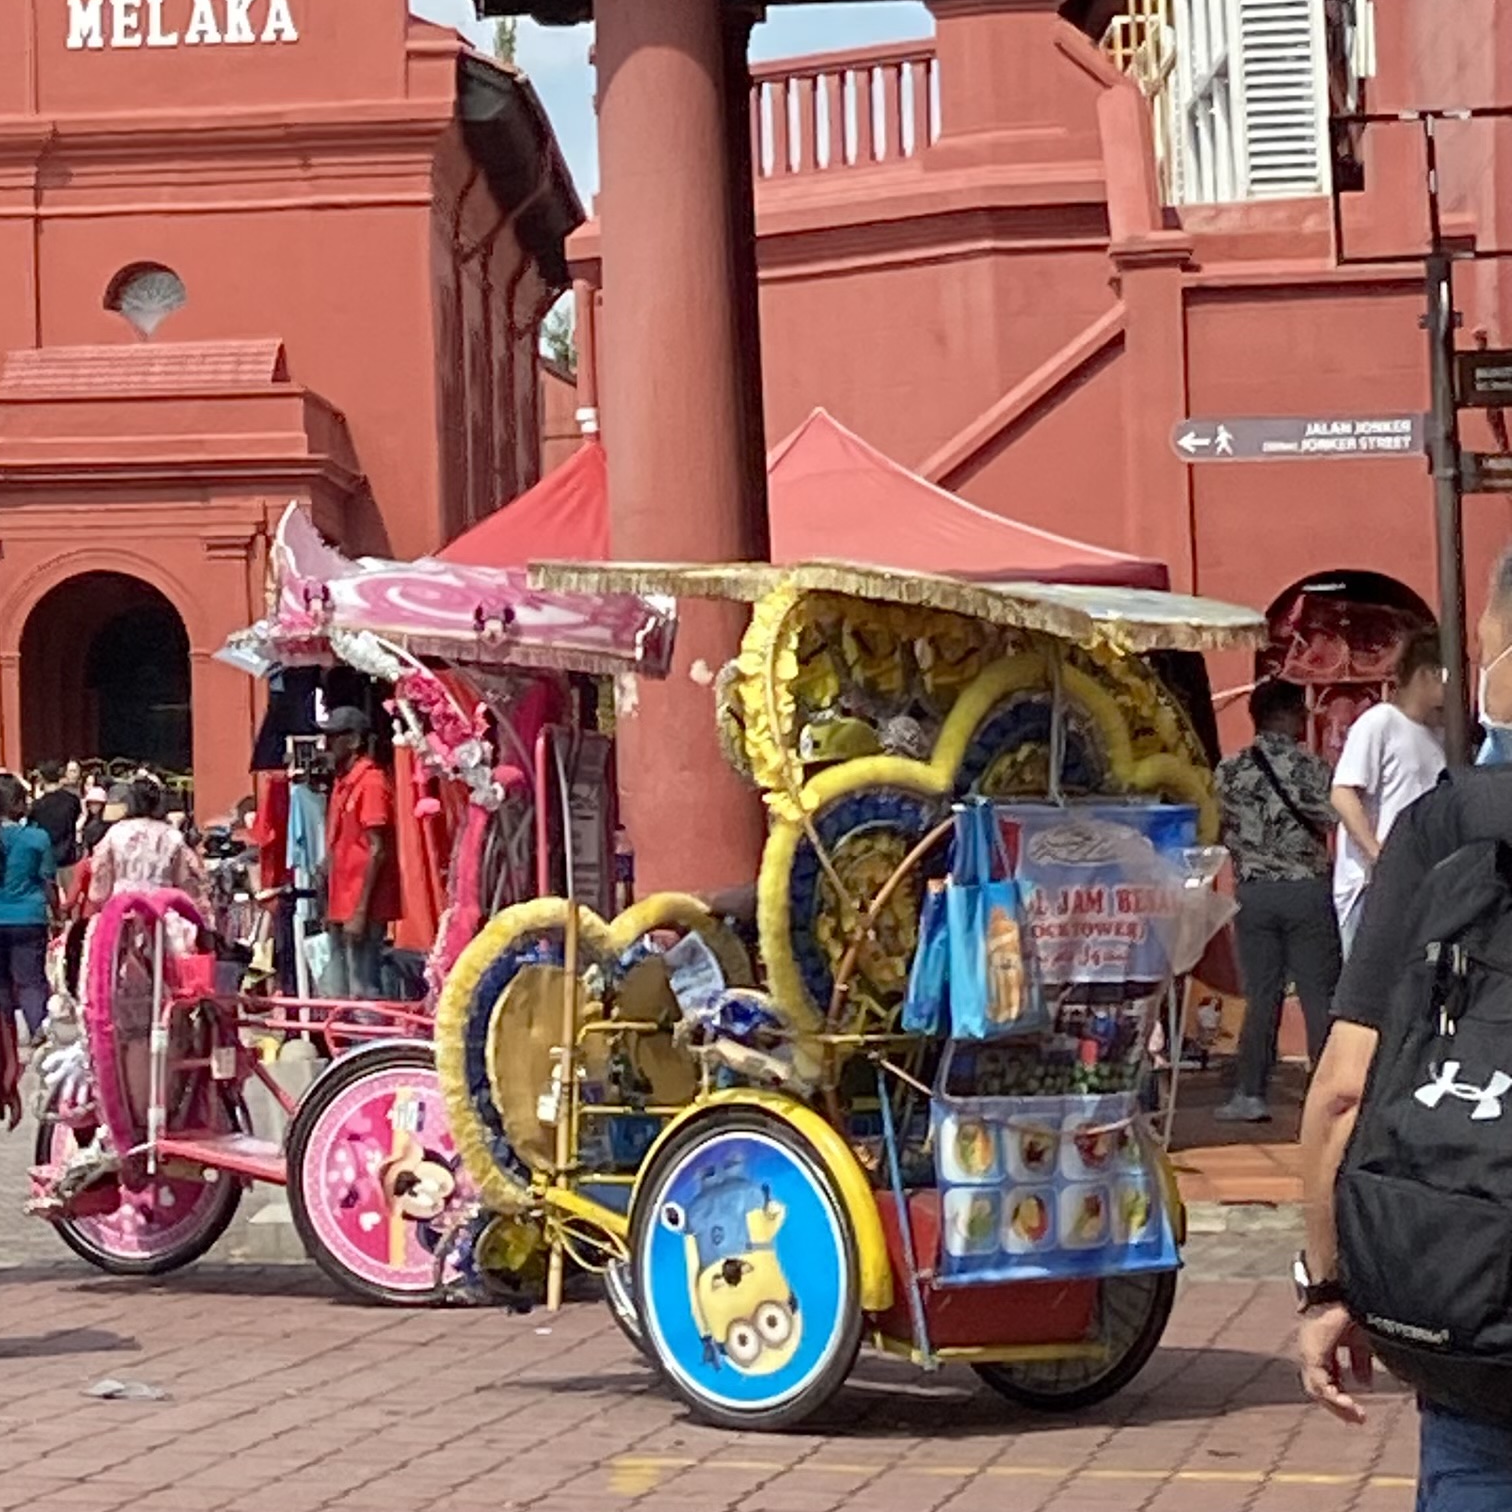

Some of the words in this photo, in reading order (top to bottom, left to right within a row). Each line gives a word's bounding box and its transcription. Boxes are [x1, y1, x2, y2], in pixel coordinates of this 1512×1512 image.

[1304, 421, 1353, 437] JALAN
[1357, 435, 1412, 450] STREET
[1056, 888, 1104, 916] JAM
